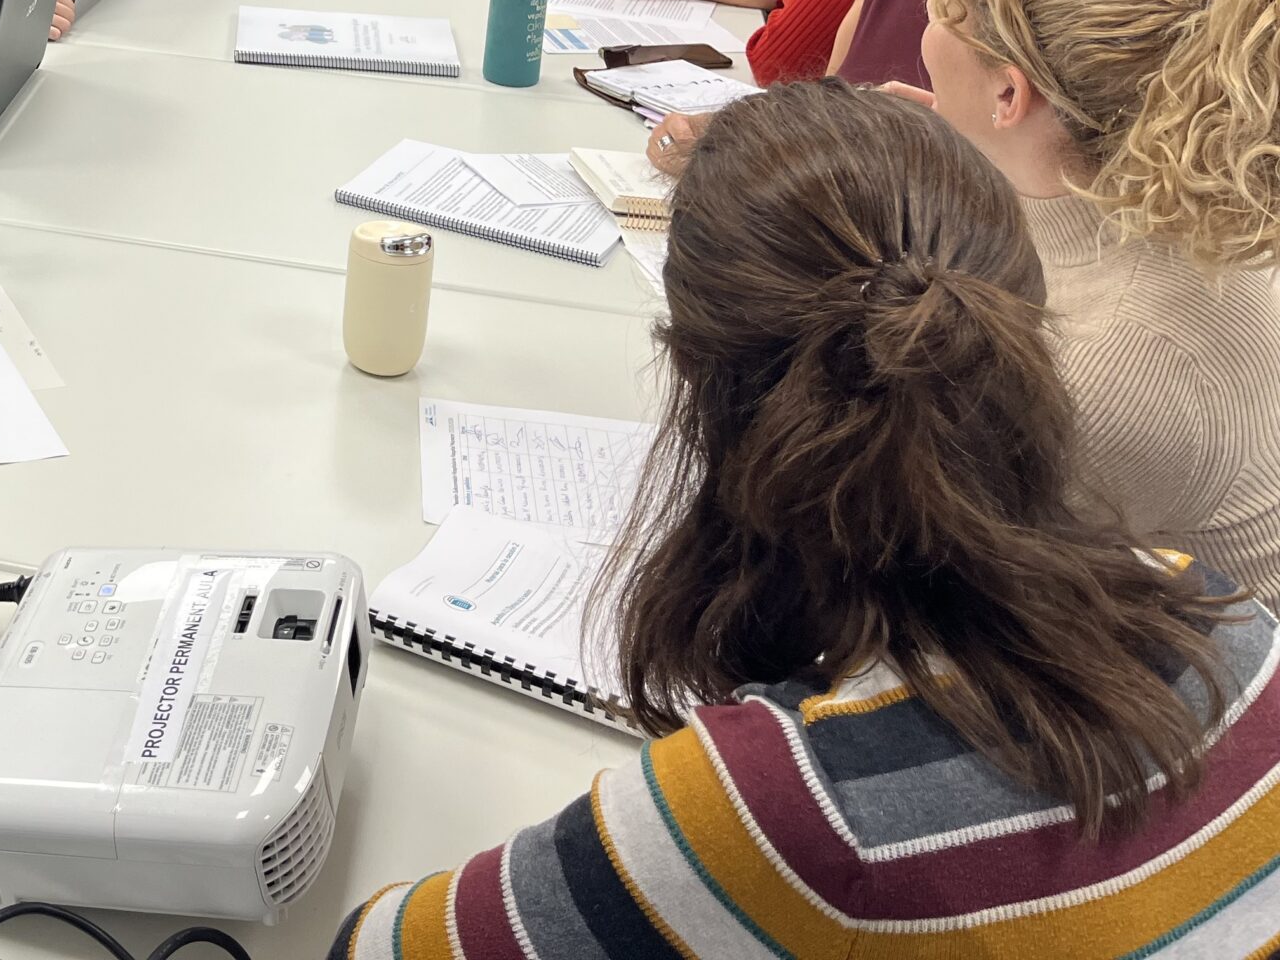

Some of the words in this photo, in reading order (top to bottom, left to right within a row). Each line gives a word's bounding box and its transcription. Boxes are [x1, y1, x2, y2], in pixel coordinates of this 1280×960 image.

[141, 675, 183, 759] PROJECTOR
[170, 600, 206, 673] PERMANENT
[200, 568, 219, 602] AULA
